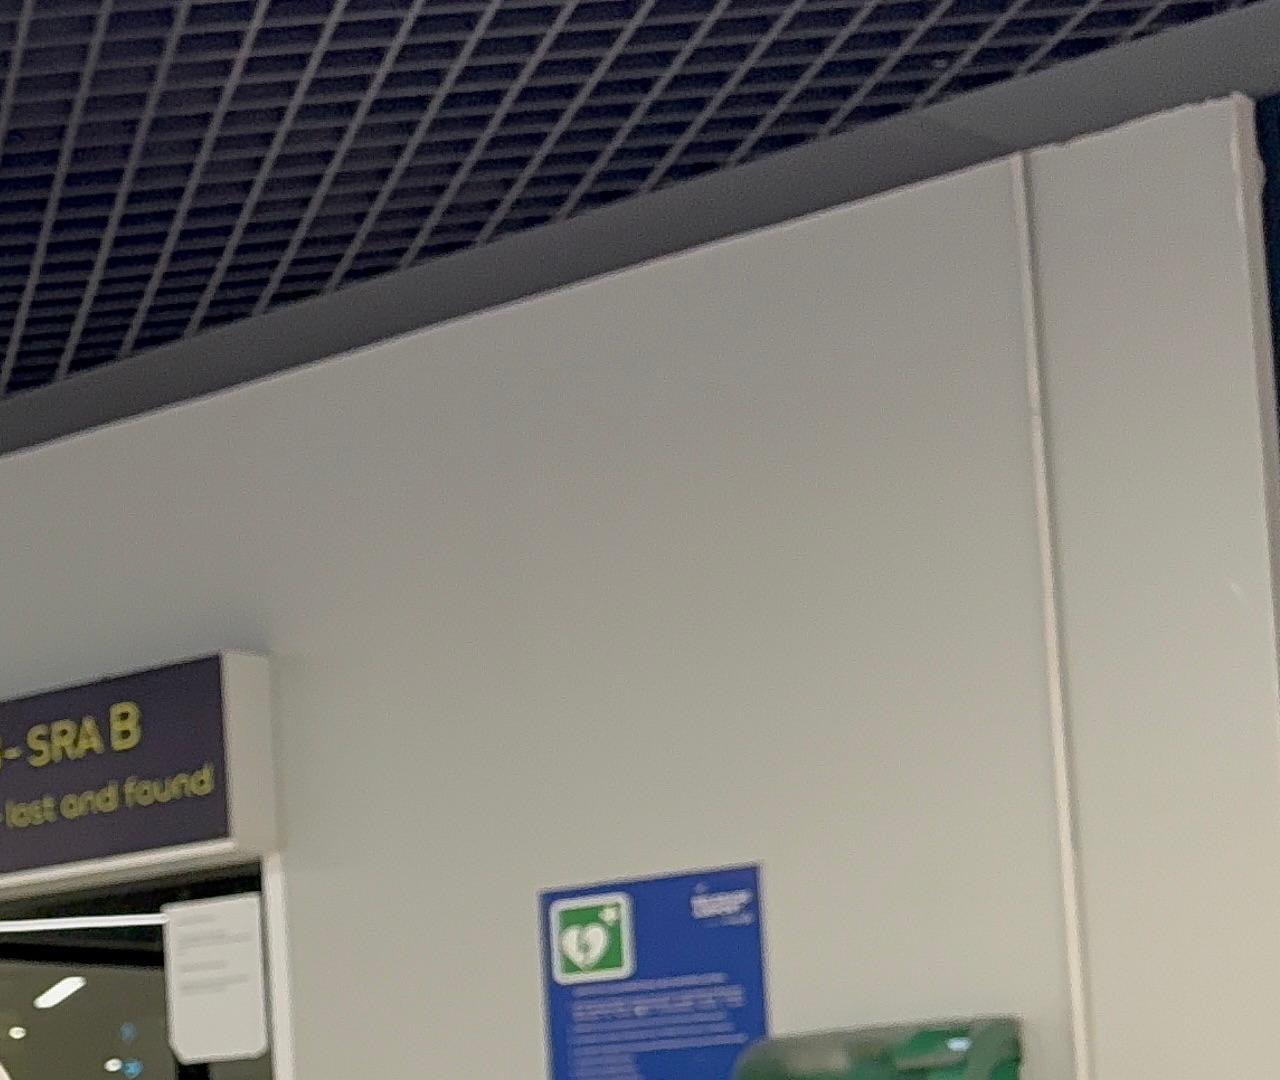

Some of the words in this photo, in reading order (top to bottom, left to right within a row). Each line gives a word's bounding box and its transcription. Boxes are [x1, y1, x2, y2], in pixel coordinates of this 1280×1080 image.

[26, 715, 106, 768] SRA
[109, 701, 142, 751] B
[6, 796, 57, 829] lost
[59, 780, 119, 820] and
[124, 762, 215, 808] found
